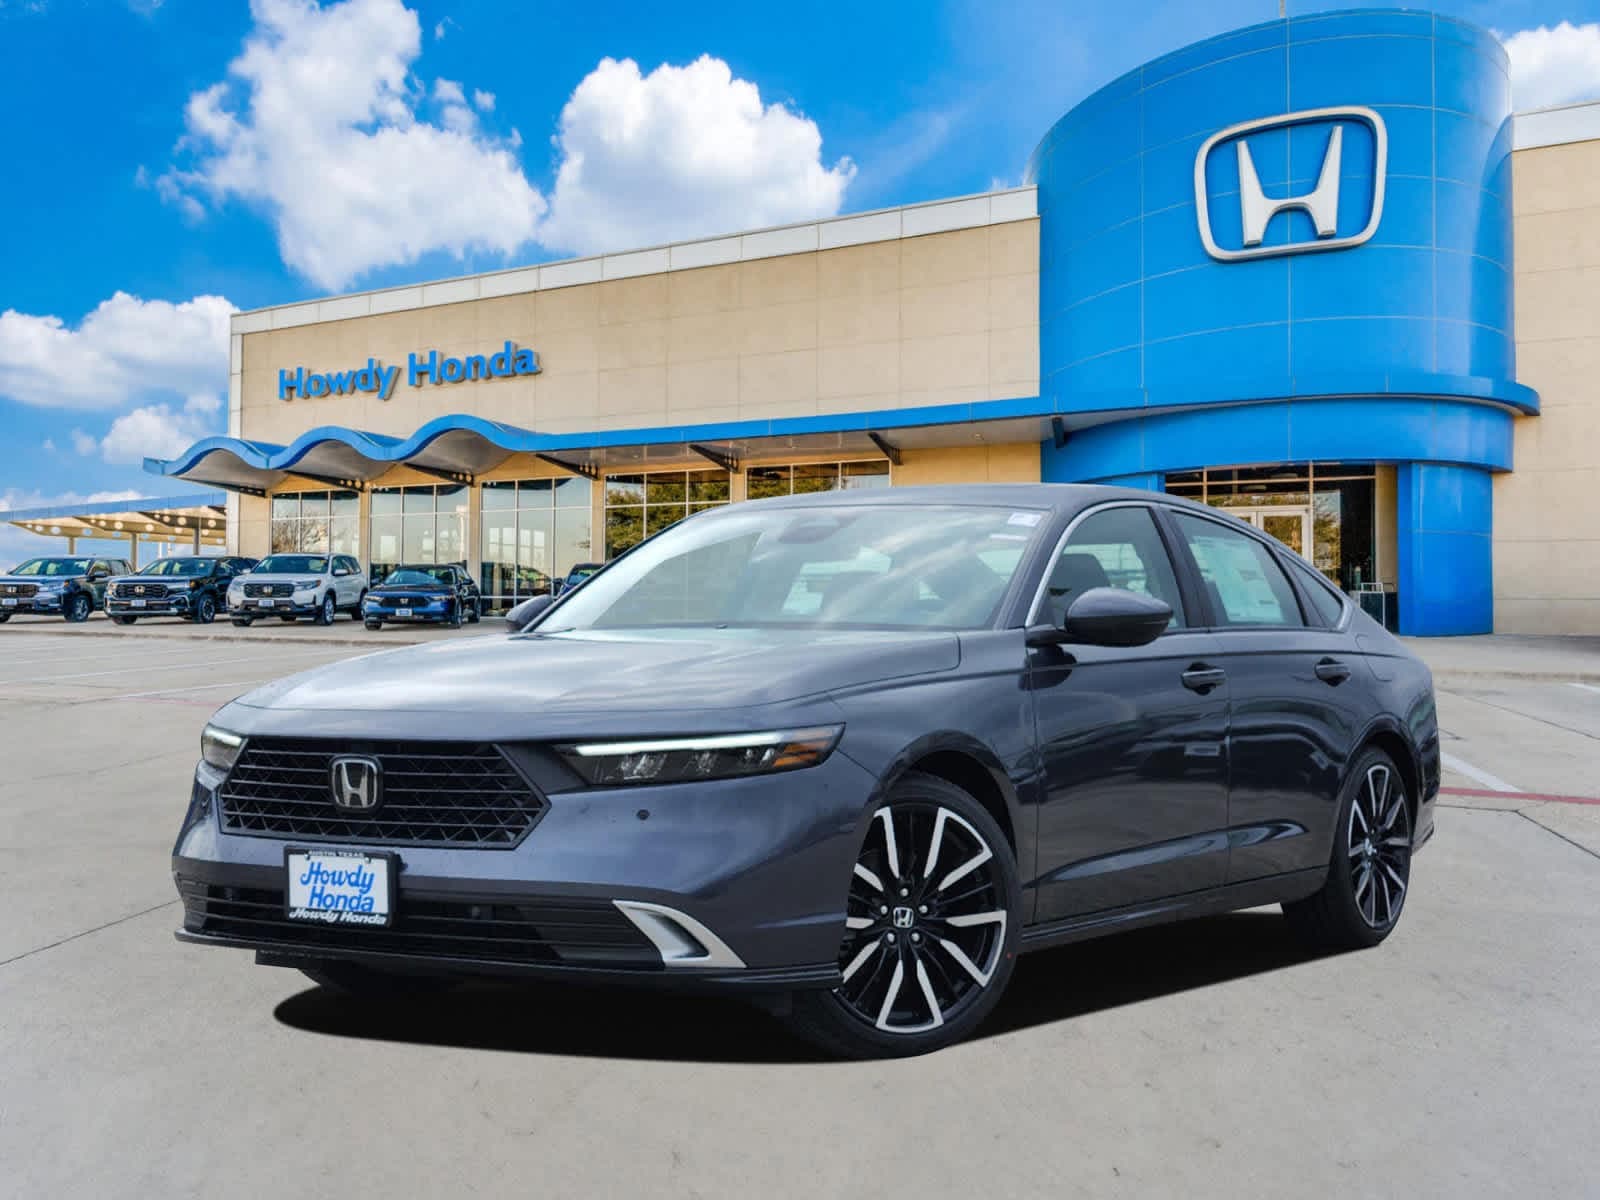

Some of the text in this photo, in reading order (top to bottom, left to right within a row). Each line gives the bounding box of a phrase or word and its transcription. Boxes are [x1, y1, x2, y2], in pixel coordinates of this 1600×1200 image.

[278, 340, 542, 400] Howdy Honda
[300, 861, 375, 895] Howdy
[308, 886, 375, 913] Honda
[289, 907, 387, 925] Howdy Honda
